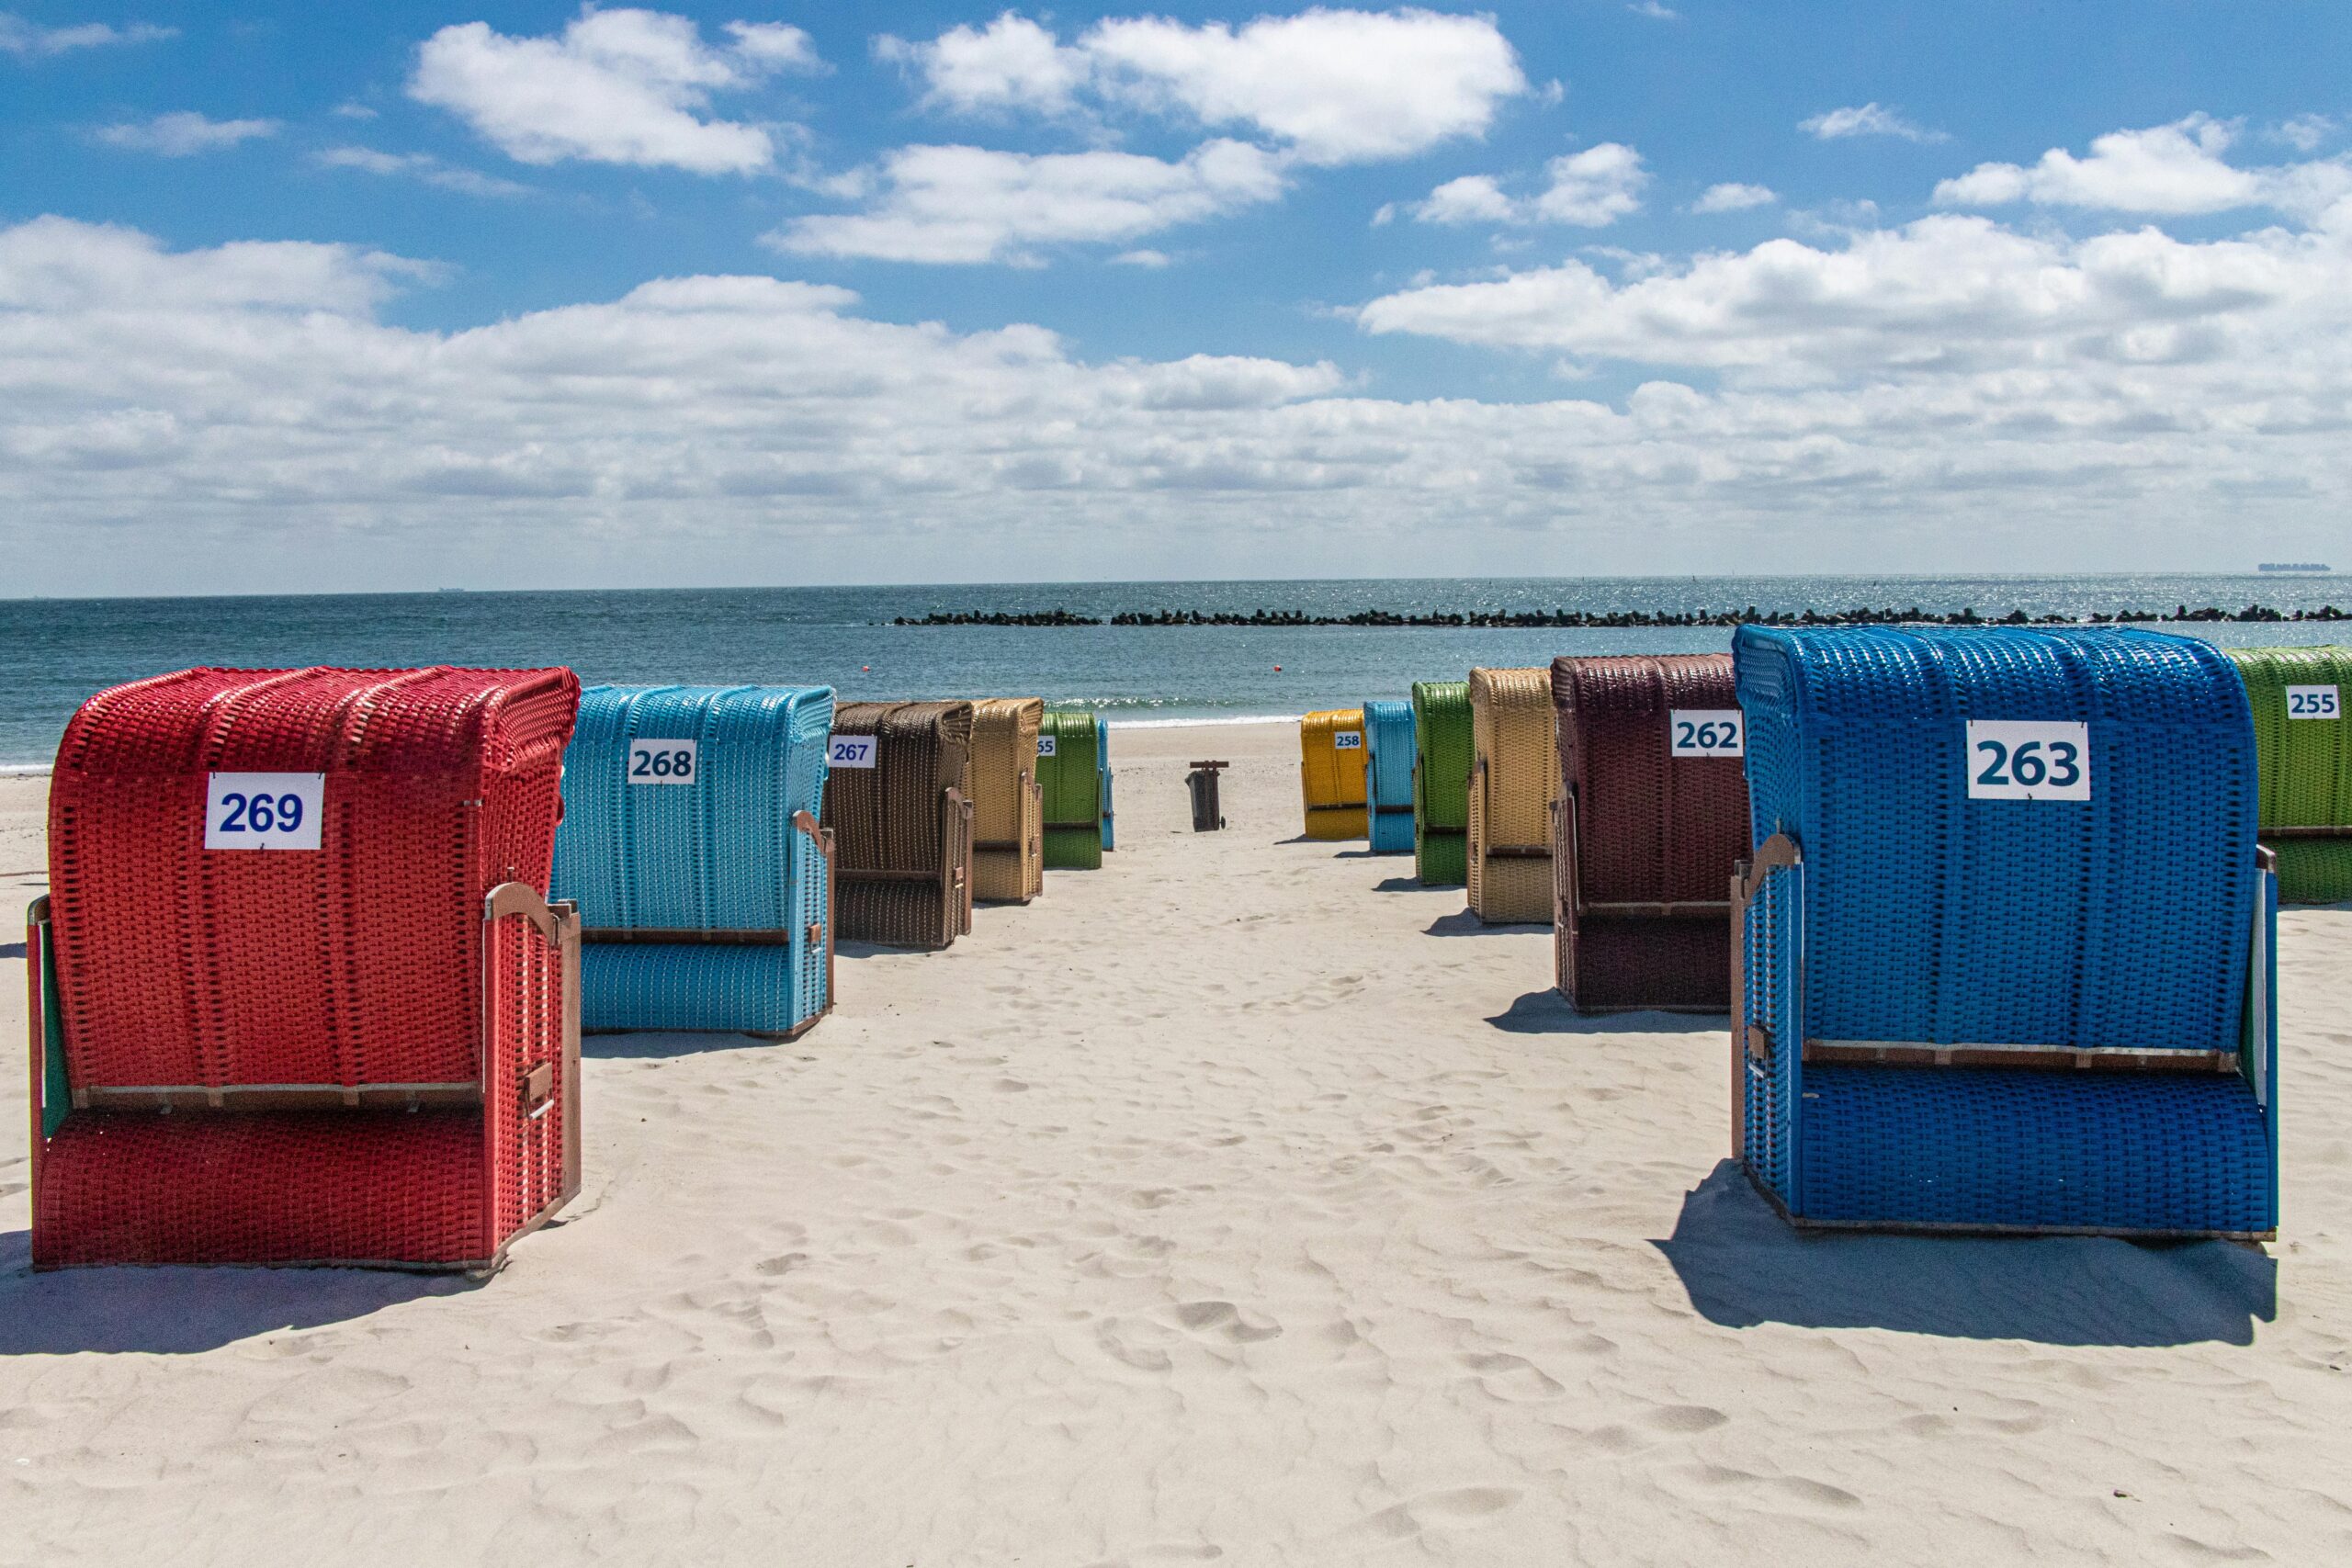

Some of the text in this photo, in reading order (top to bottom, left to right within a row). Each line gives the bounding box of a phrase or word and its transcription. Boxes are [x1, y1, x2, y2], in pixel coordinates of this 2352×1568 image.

[2290, 694, 2335, 714] 255
[1037, 740, 1054, 753] 65
[1337, 736, 1360, 747] 258
[1677, 722, 1738, 749] 262
[632, 750, 692, 777] 268
[833, 743, 869, 761] 267
[1976, 740, 2080, 787] 263
[219, 793, 303, 833] 269
